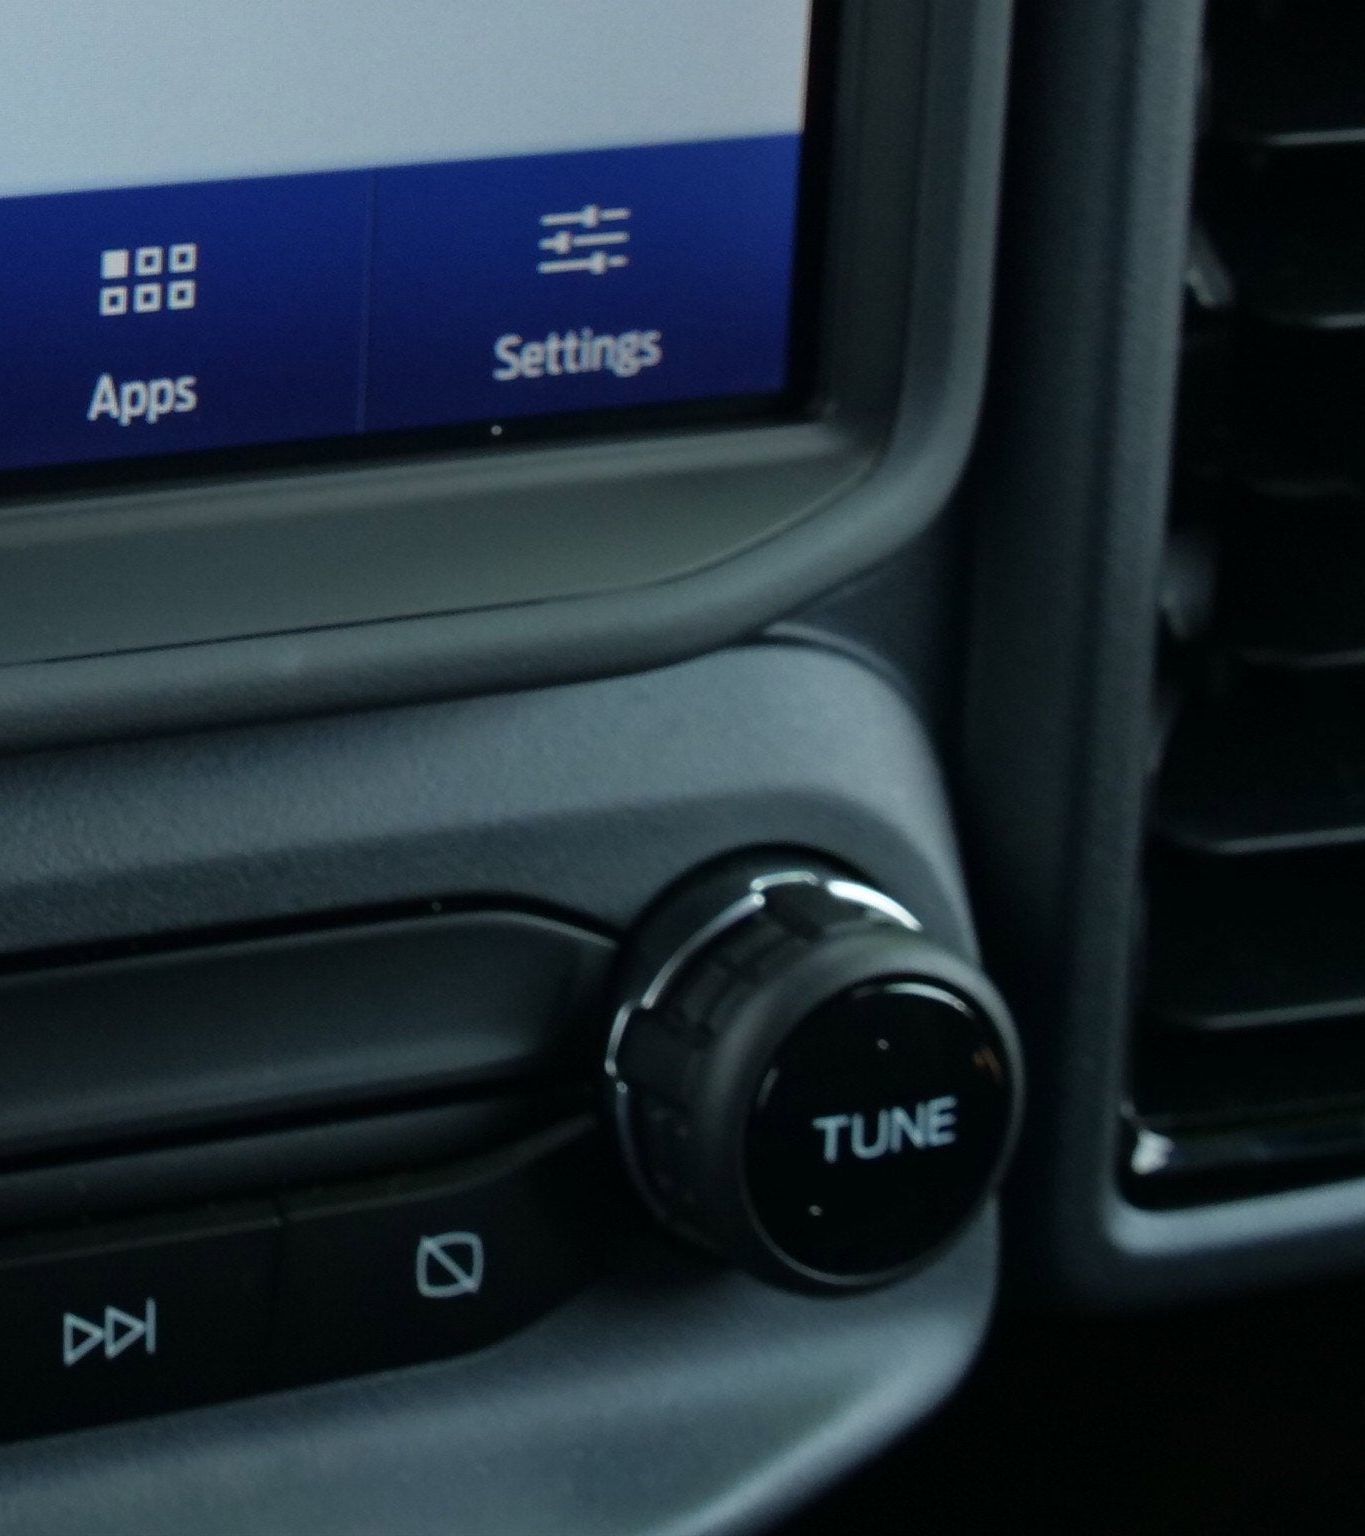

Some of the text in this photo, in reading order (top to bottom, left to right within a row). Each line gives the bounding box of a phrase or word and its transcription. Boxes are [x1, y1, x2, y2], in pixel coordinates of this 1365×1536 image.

[494, 328, 662, 381] Settings
[87, 373, 198, 426] Apps
[812, 1095, 959, 1164] TUNE
